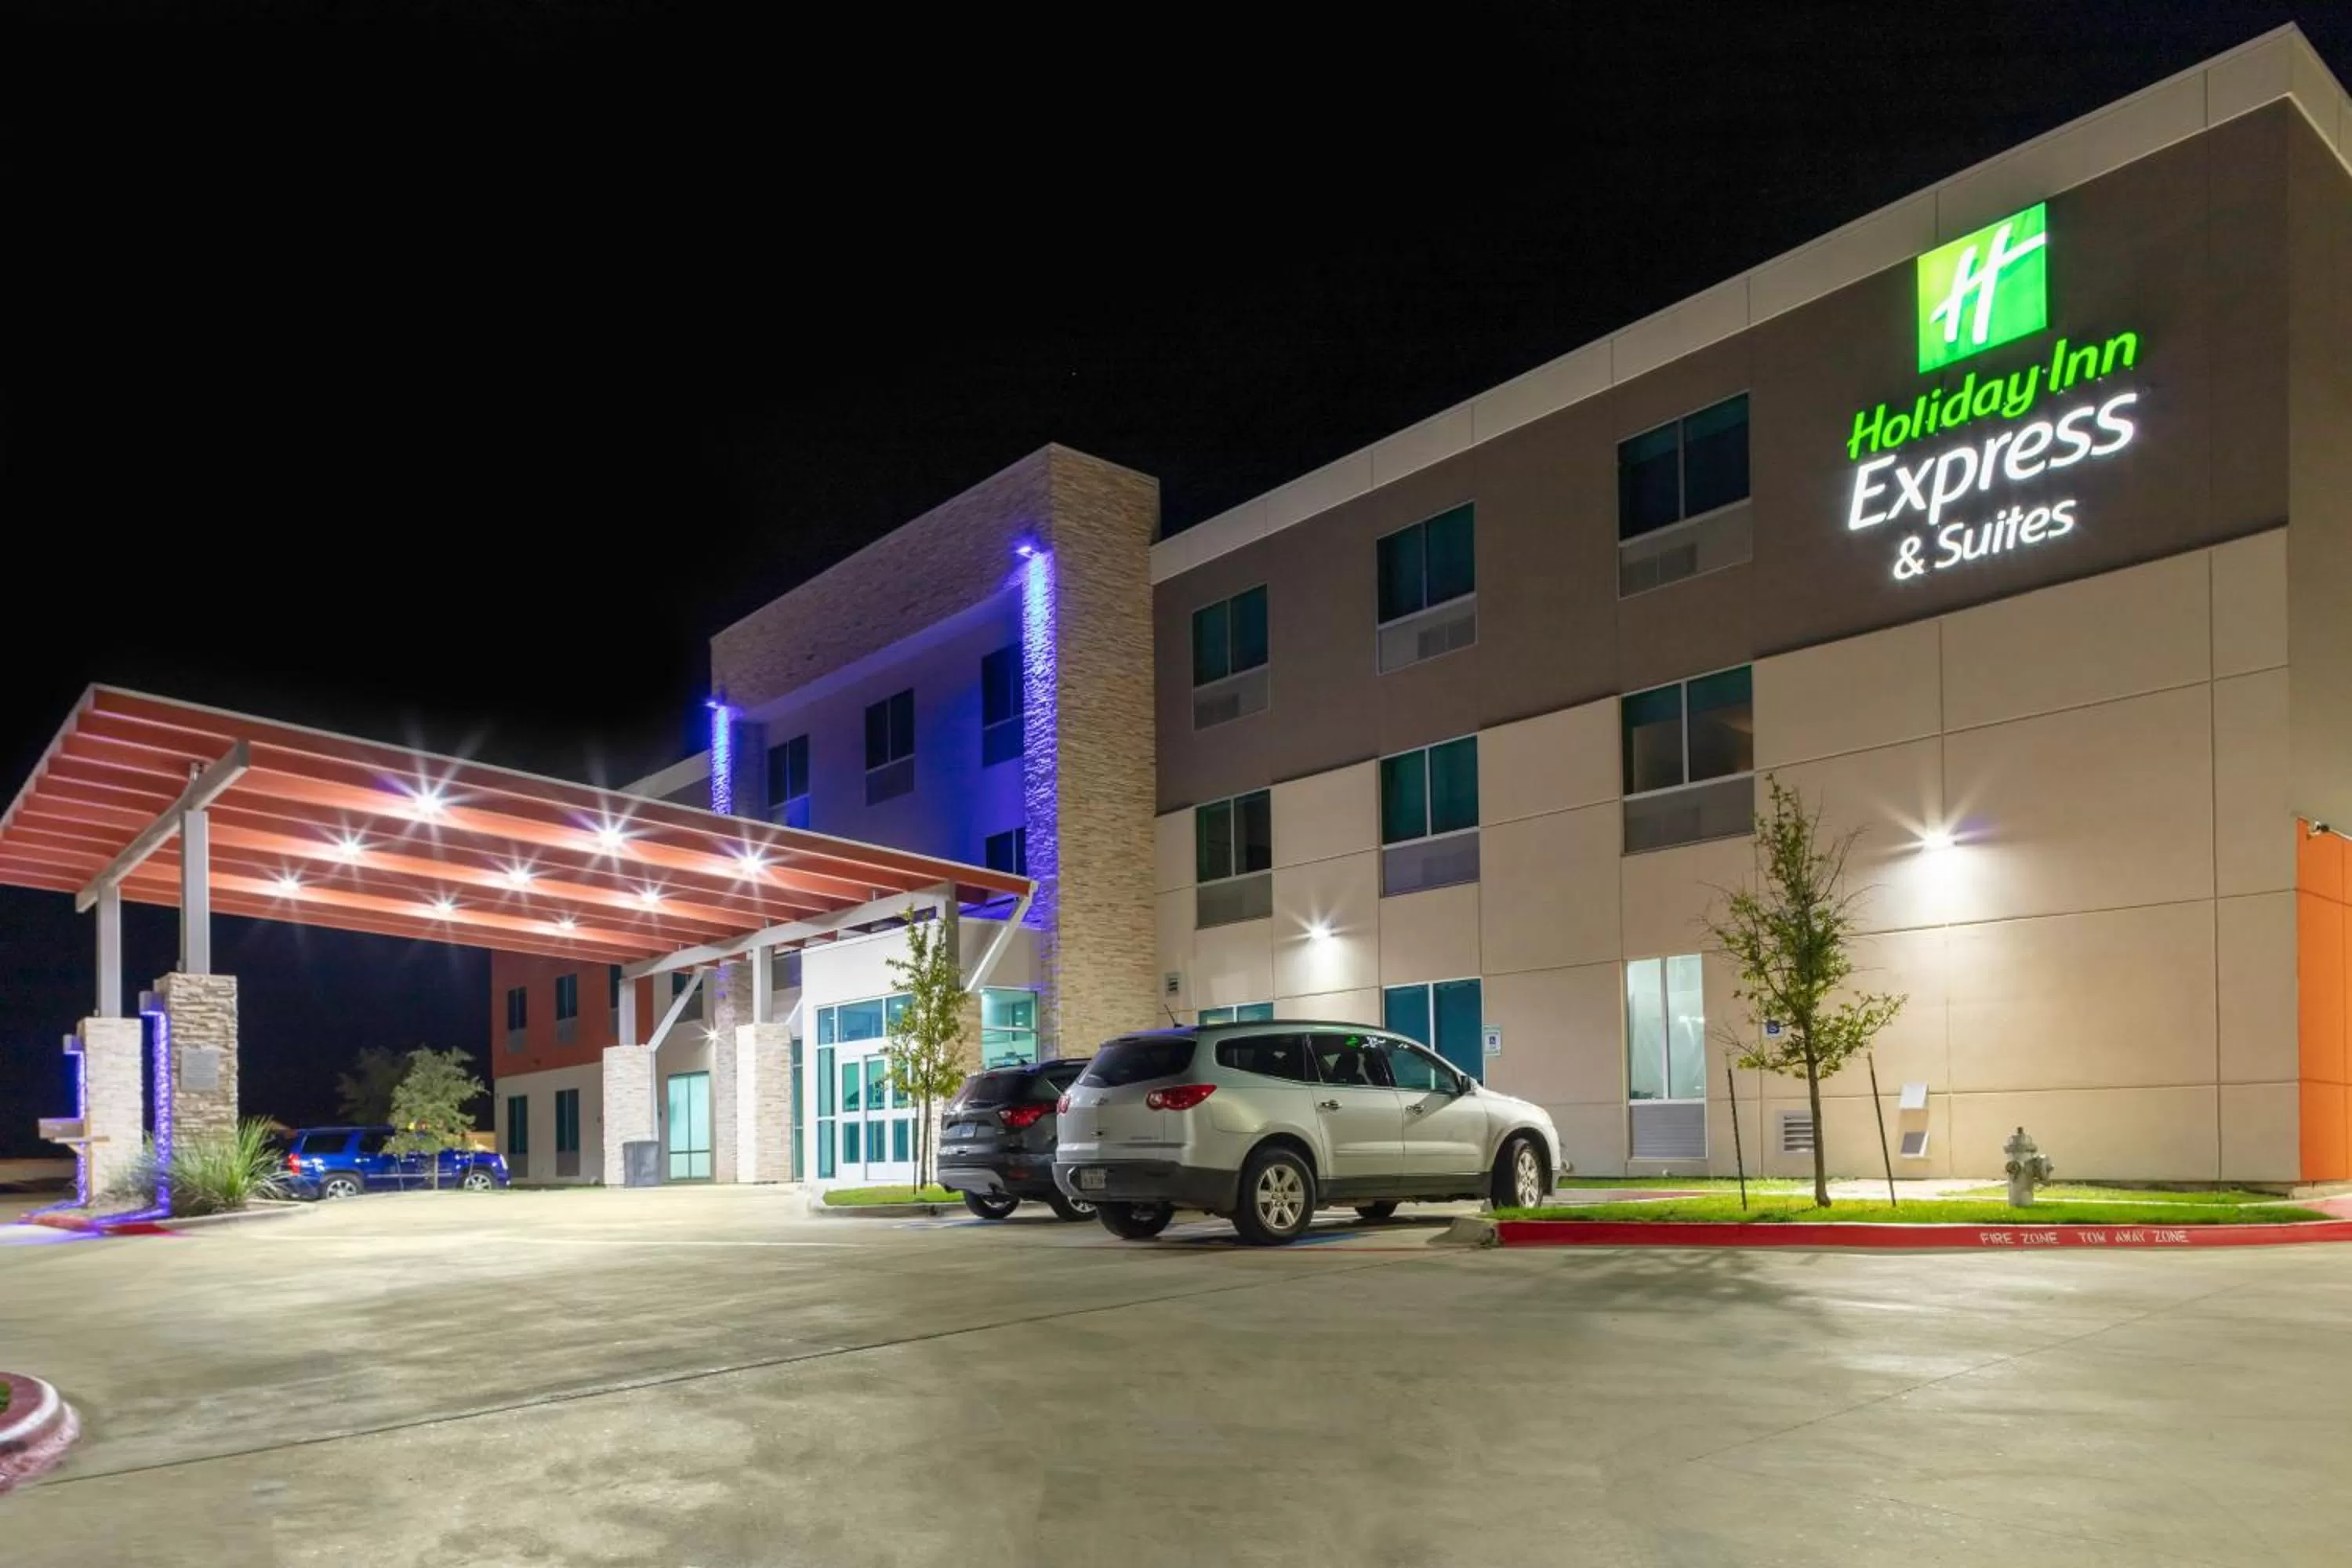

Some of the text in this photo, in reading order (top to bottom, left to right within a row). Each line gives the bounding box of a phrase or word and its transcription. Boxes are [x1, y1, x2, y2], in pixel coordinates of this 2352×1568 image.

[1847, 331, 2138, 459] Holiday Inn
[1847, 392, 2138, 531] Express
[1892, 499, 2077, 579] & Suites
[1980, 1229, 2190, 1245] FIRE ZONE TOW AWAY ZONE
